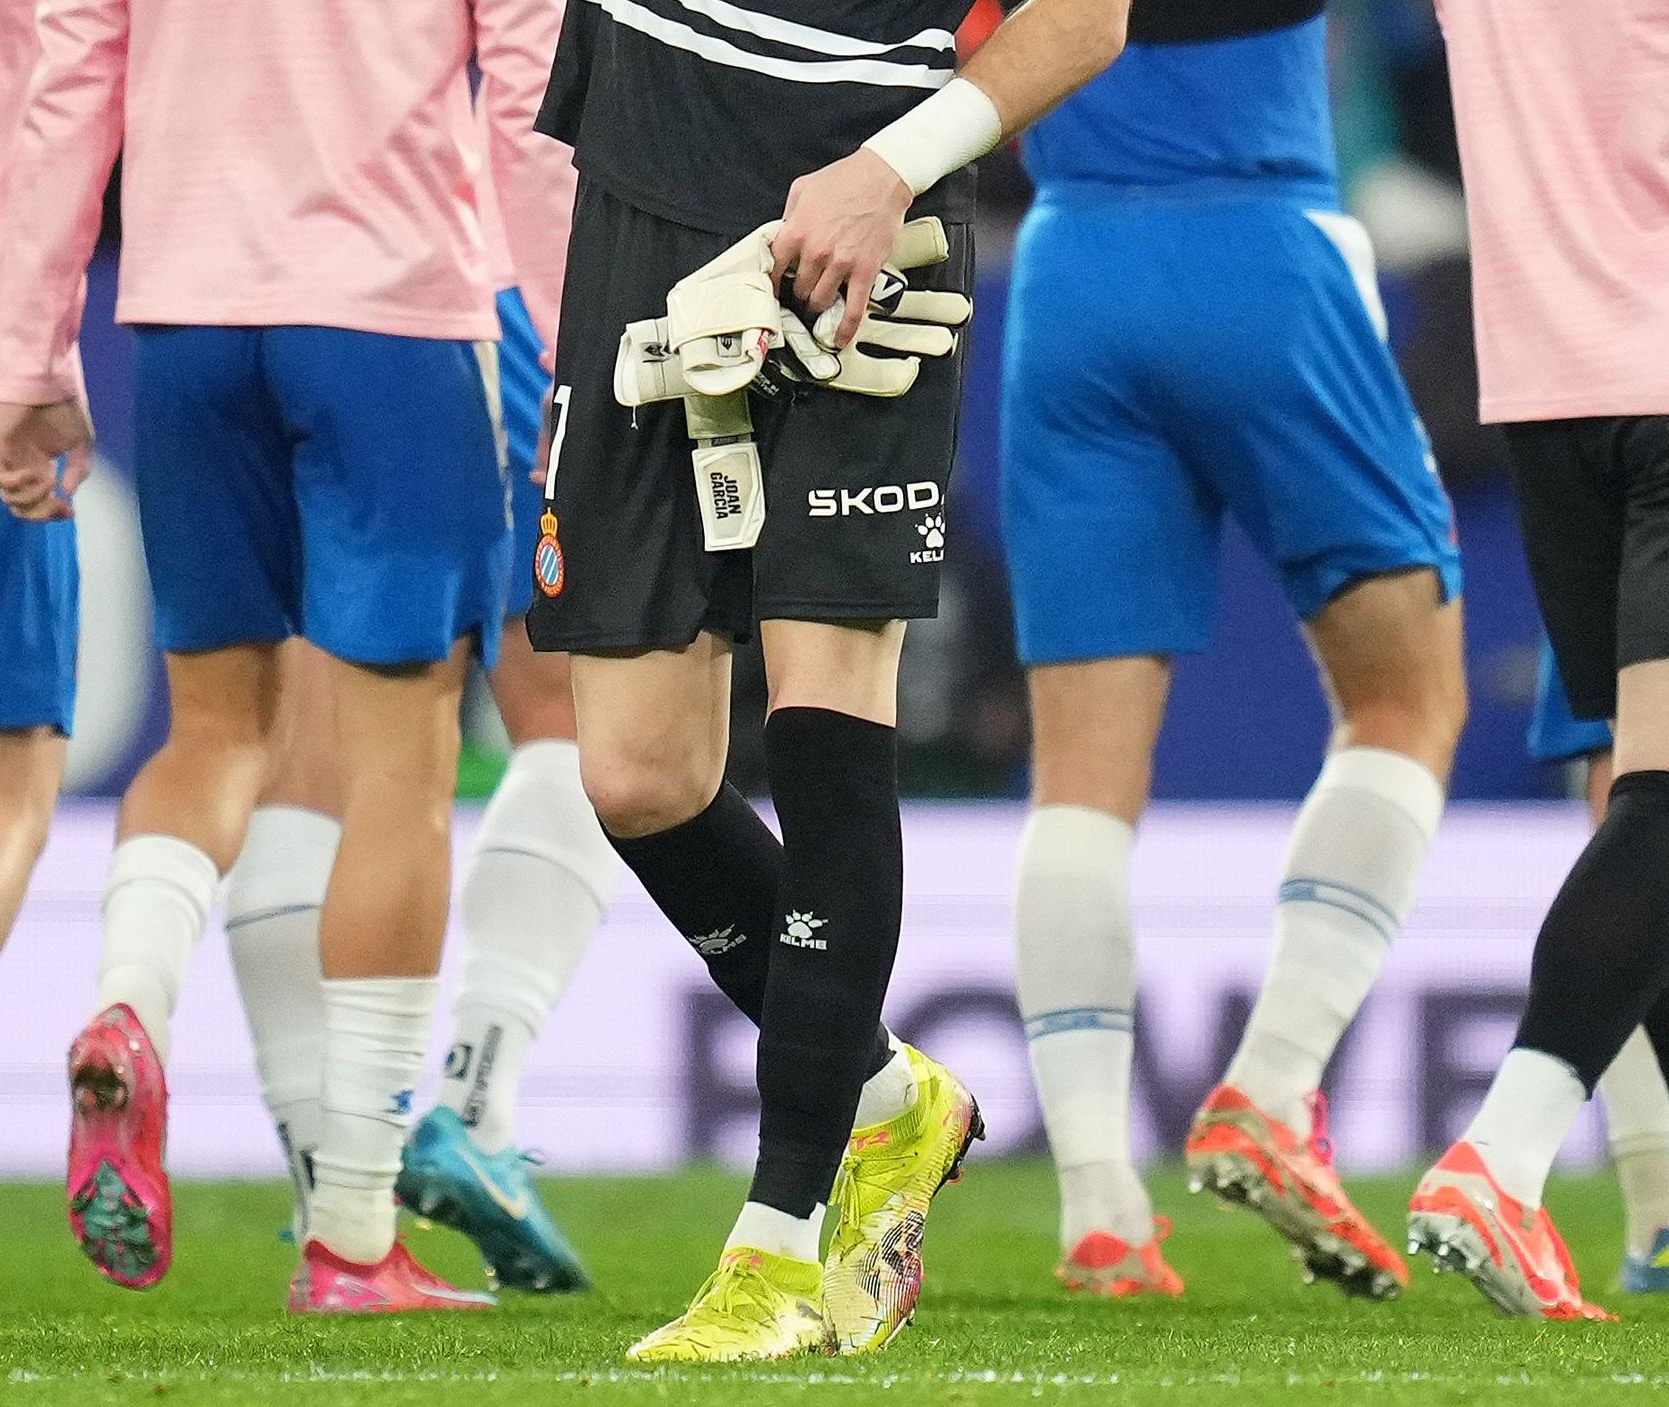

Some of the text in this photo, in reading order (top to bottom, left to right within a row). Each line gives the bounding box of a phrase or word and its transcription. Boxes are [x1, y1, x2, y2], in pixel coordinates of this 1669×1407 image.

[710, 472, 729, 520] GARCIA
[724, 475, 742, 515] JOAN
[808, 481, 945, 516] SKOD
